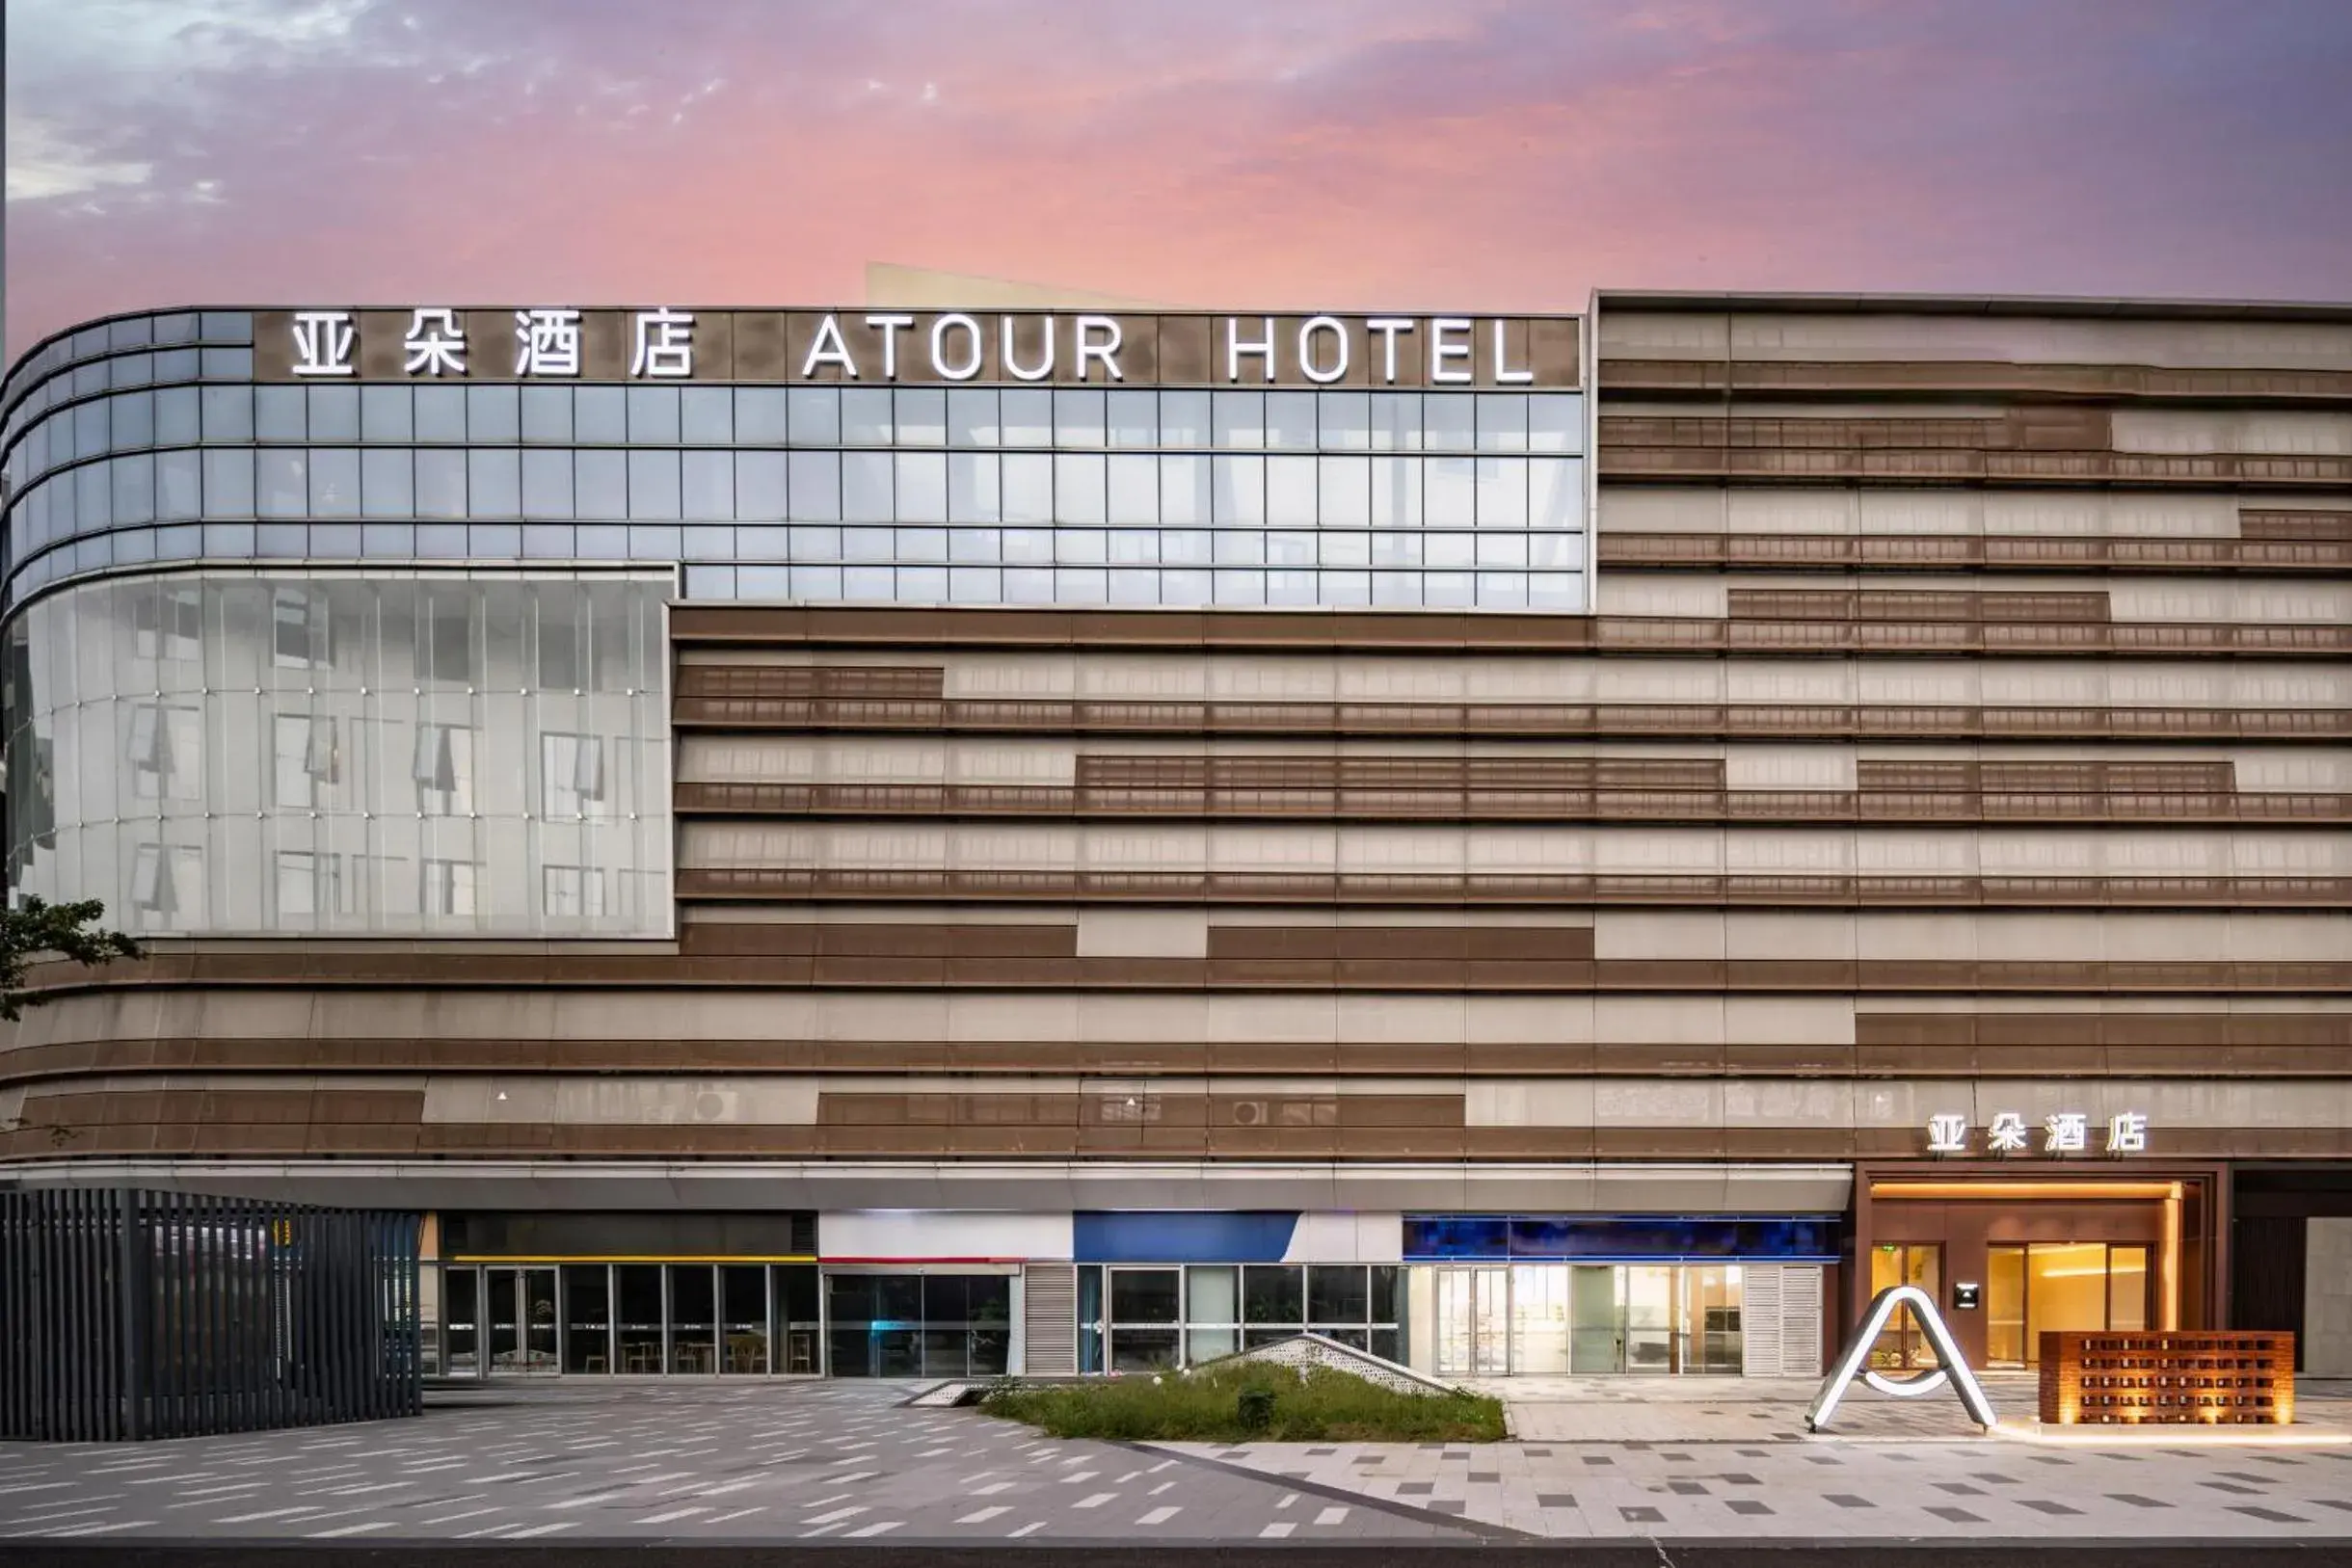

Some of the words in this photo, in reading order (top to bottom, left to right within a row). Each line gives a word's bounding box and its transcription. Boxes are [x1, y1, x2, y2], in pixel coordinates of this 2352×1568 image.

[292, 306, 694, 377] 亚朵酒店
[802, 314, 1123, 380] ATOUR
[1228, 316, 1534, 382] HOTEL
[1927, 1111, 2148, 1152] 亚朵酒店
